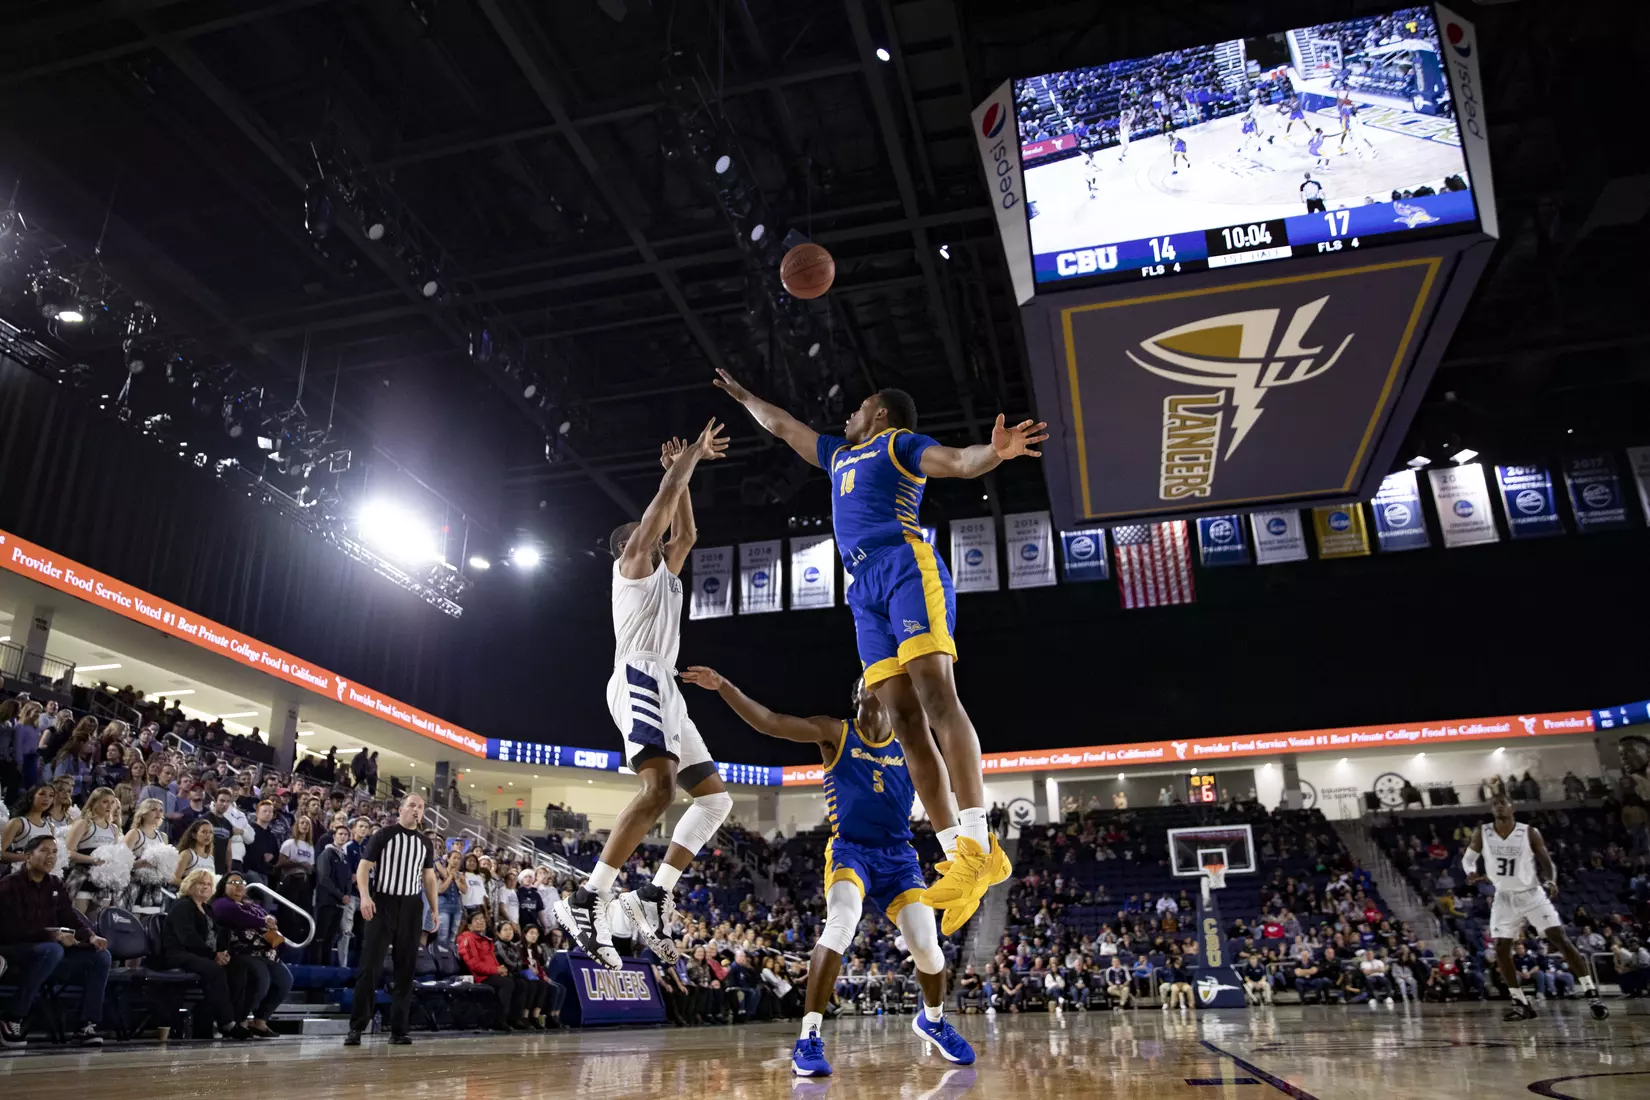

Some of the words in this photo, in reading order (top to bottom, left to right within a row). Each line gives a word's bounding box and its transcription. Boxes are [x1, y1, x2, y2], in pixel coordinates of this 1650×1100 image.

[1454, 60, 1484, 140] pepsi
[989, 139, 1020, 210] pepsi
[1221, 223, 1272, 250] 10:04
[1324, 210, 1350, 237] 17
[1148, 236, 1176, 262] 14
[1223, 255, 1244, 264] 1ST
[1255, 250, 1279, 259] HALF
[1317, 240, 1343, 253] FLS
[1351, 237, 1360, 248] 4
[1056, 245, 1118, 277] CBU
[1141, 264, 1165, 277] FLS
[1173, 262, 1182, 273] 4
[1159, 389, 1226, 501] LANCERS
[840, 468, 856, 497] 10
[11, 546, 63, 579] Provider
[63, 568, 95, 593] Food
[94, 582, 132, 608] Service
[134, 597, 162, 621] Voted
[162, 611, 176, 626] #1
[177, 616, 198, 635] Best
[197, 625, 229, 648] Private
[230, 639, 261, 662] College
[260, 652, 282, 670] Food
[281, 660, 290, 674] in
[290, 664, 328, 689] California!
[349, 688, 376, 708] Provider
[375, 699, 392, 715] Food
[391, 706, 412, 723] Service
[411, 714, 428, 731] Voted
[463, 735, 482, 753] College
[1543, 717, 1585, 729] Provider
[1193, 742, 1230, 755] Provider
[1231, 741, 1255, 751] Food
[1256, 739, 1288, 750] Service
[1288, 736, 1315, 747] Voted
[1330, 733, 1350, 745] Best
[1351, 732, 1384, 743] Private
[1384, 728, 1421, 741] College
[1421, 726, 1446, 738] Food
[1447, 726, 1458, 736] in
[1458, 722, 1511, 735] California!
[574, 750, 609, 769] CBU
[1000, 757, 1019, 768] Best
[1018, 755, 1049, 767] Private
[1049, 753, 1083, 765] College
[1083, 751, 1106, 763] Food
[1105, 750, 1116, 761] in
[1116, 748, 1164, 760] California!
[873, 769, 884, 793] 5
[1496, 857, 1516, 877] 31
[1203, 917, 1222, 968] CBU
[580, 967, 651, 1001] LANCERS
